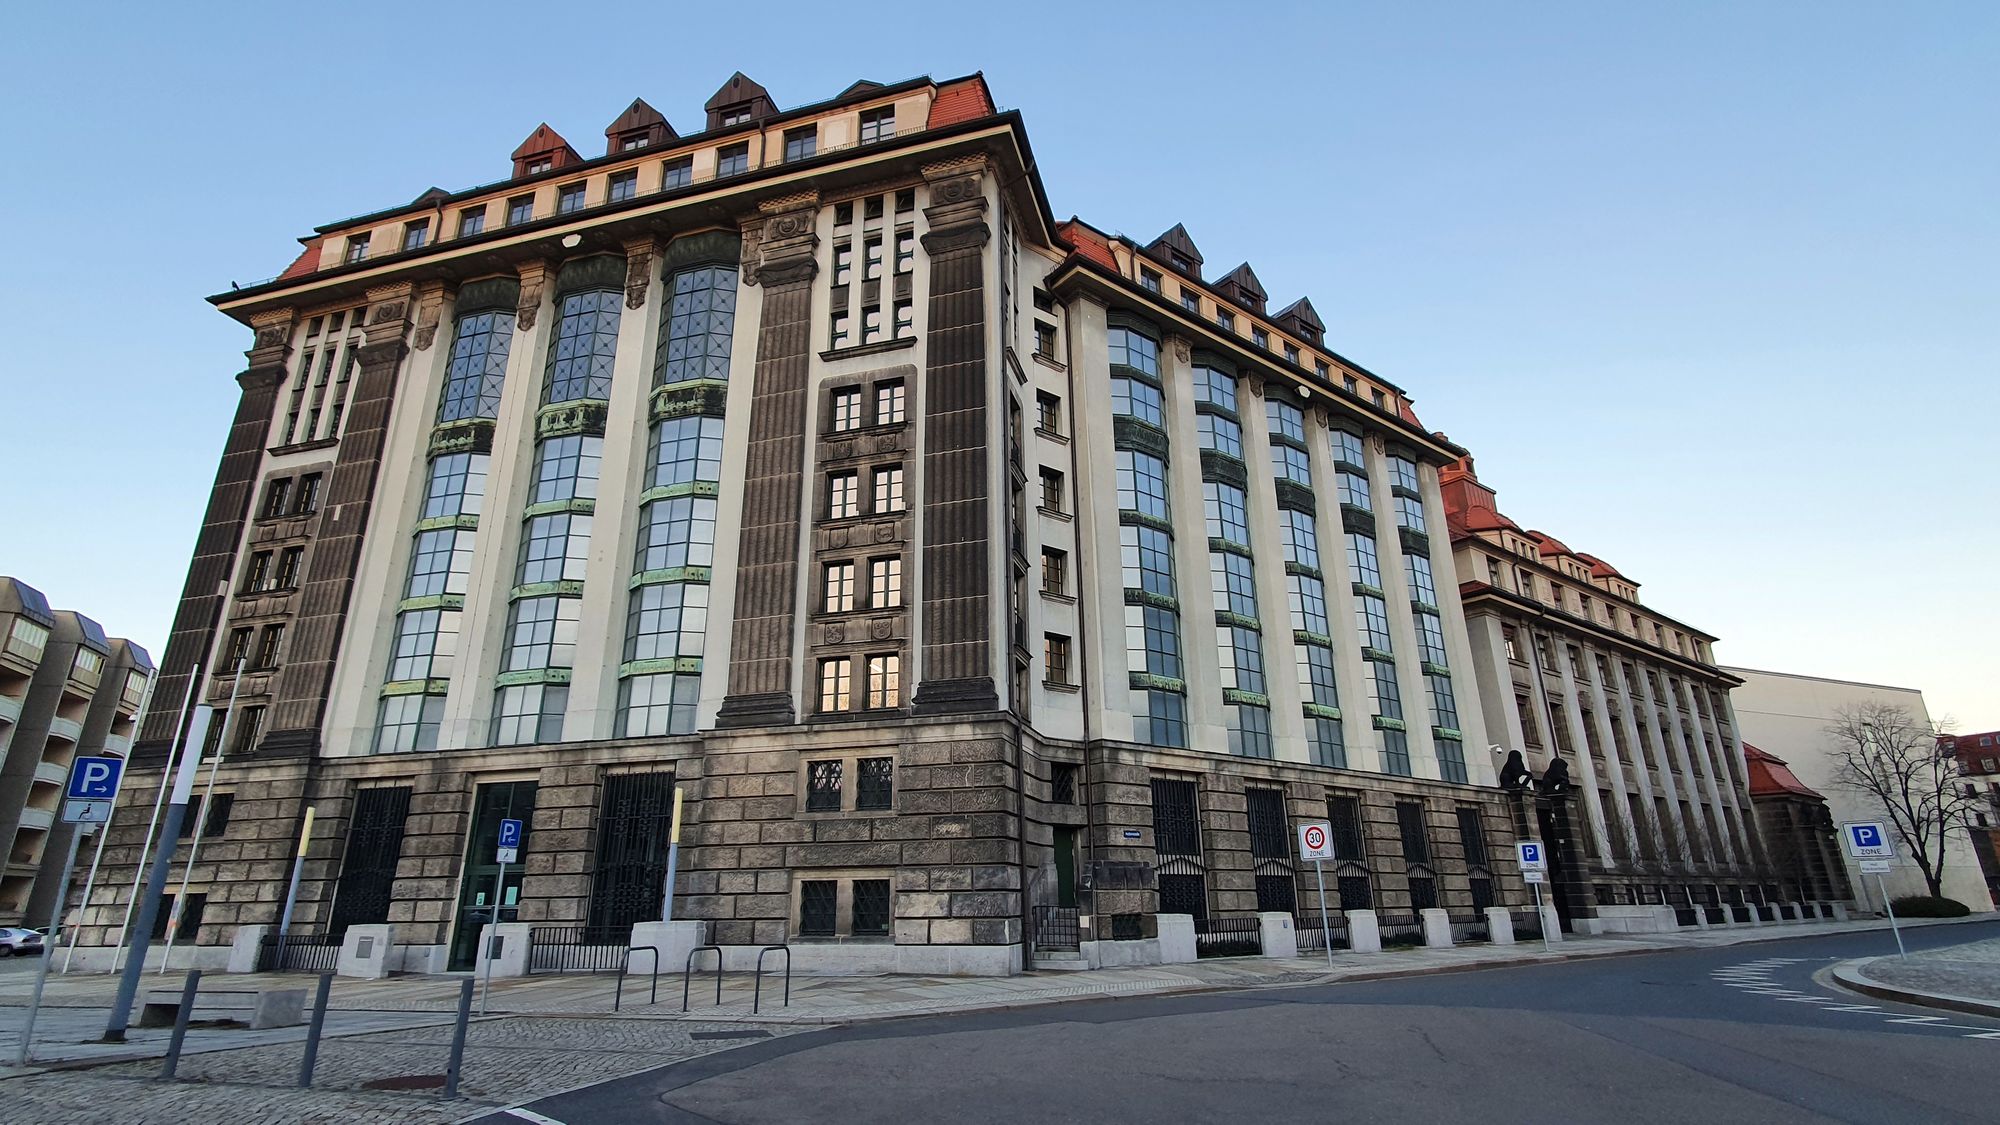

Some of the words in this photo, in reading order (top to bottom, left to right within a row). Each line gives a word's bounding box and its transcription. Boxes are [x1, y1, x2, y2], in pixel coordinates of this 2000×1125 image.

[80, 763, 109, 792] P
[502, 823, 515, 843] P
[1309, 832, 1321, 844] 30
[1858, 829, 1872, 844] P
[1525, 847, 1534, 859] P
